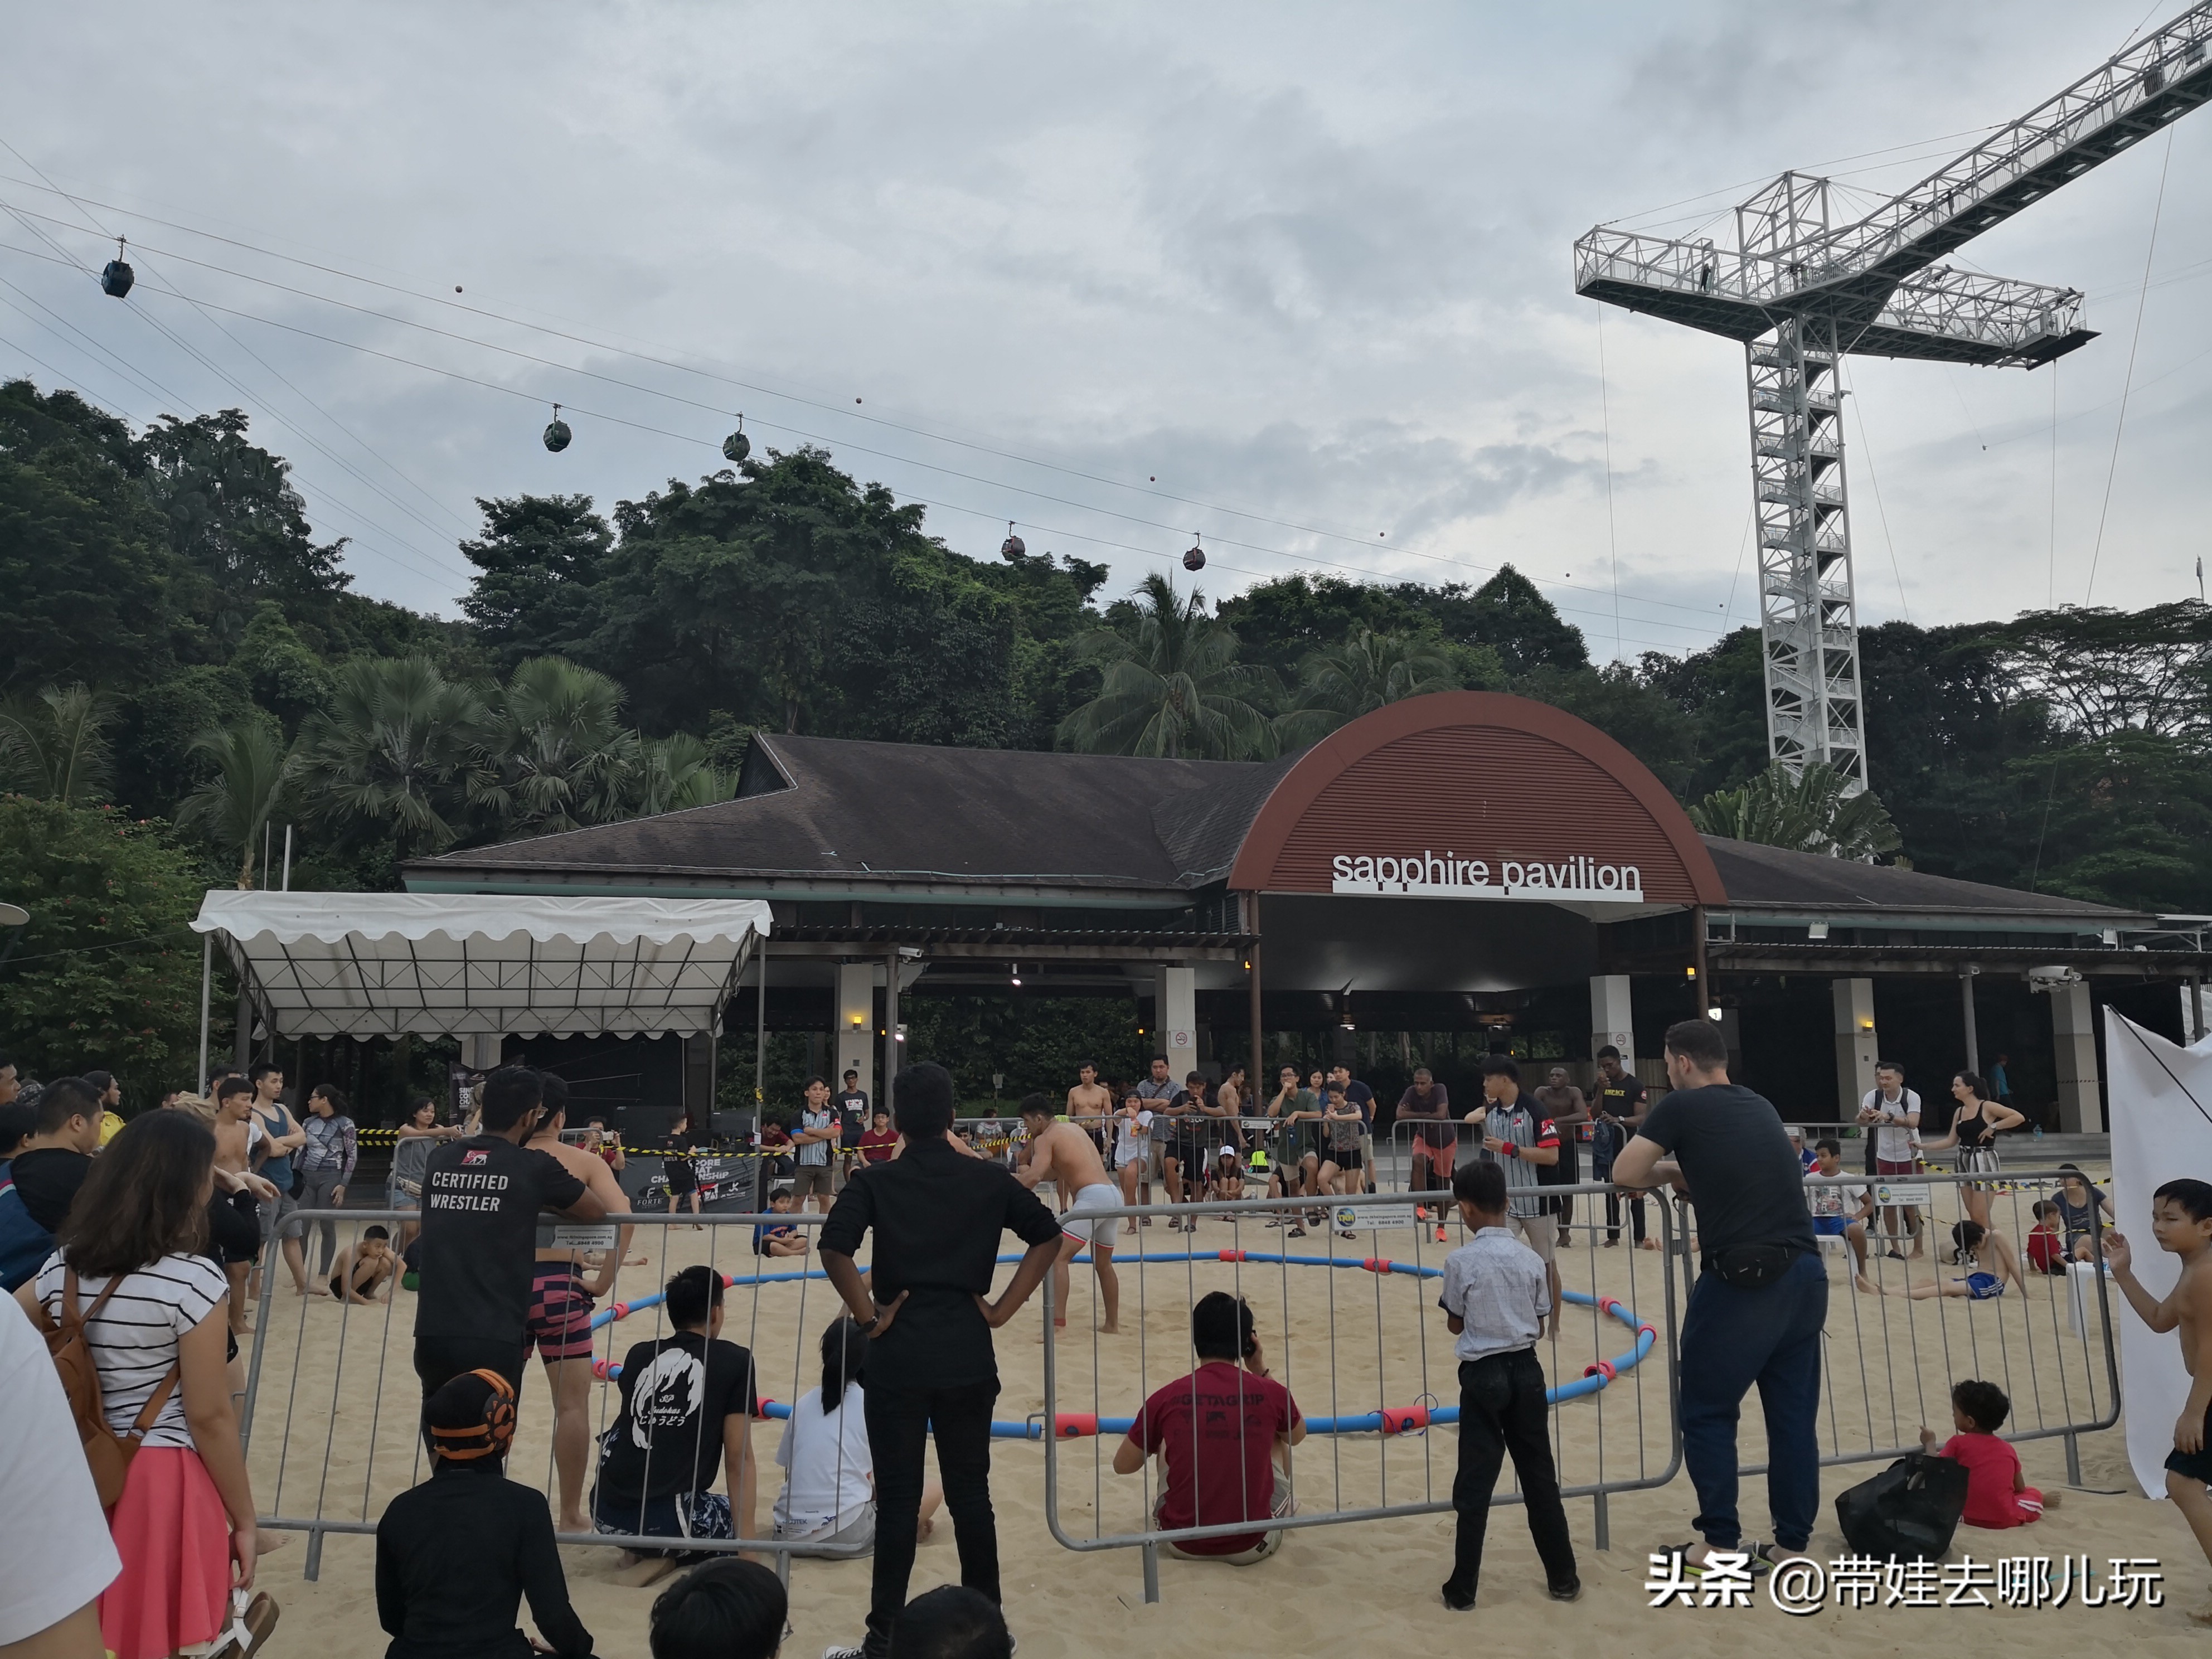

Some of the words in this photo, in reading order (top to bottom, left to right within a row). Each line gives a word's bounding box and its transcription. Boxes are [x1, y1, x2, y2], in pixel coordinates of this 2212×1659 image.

[1333, 850, 1489, 891] sapphire
[1502, 856, 1641, 896] pavilion
[432, 1172, 508, 1190] CERTIFIED
[430, 1194, 500, 1211] WRESTLER
